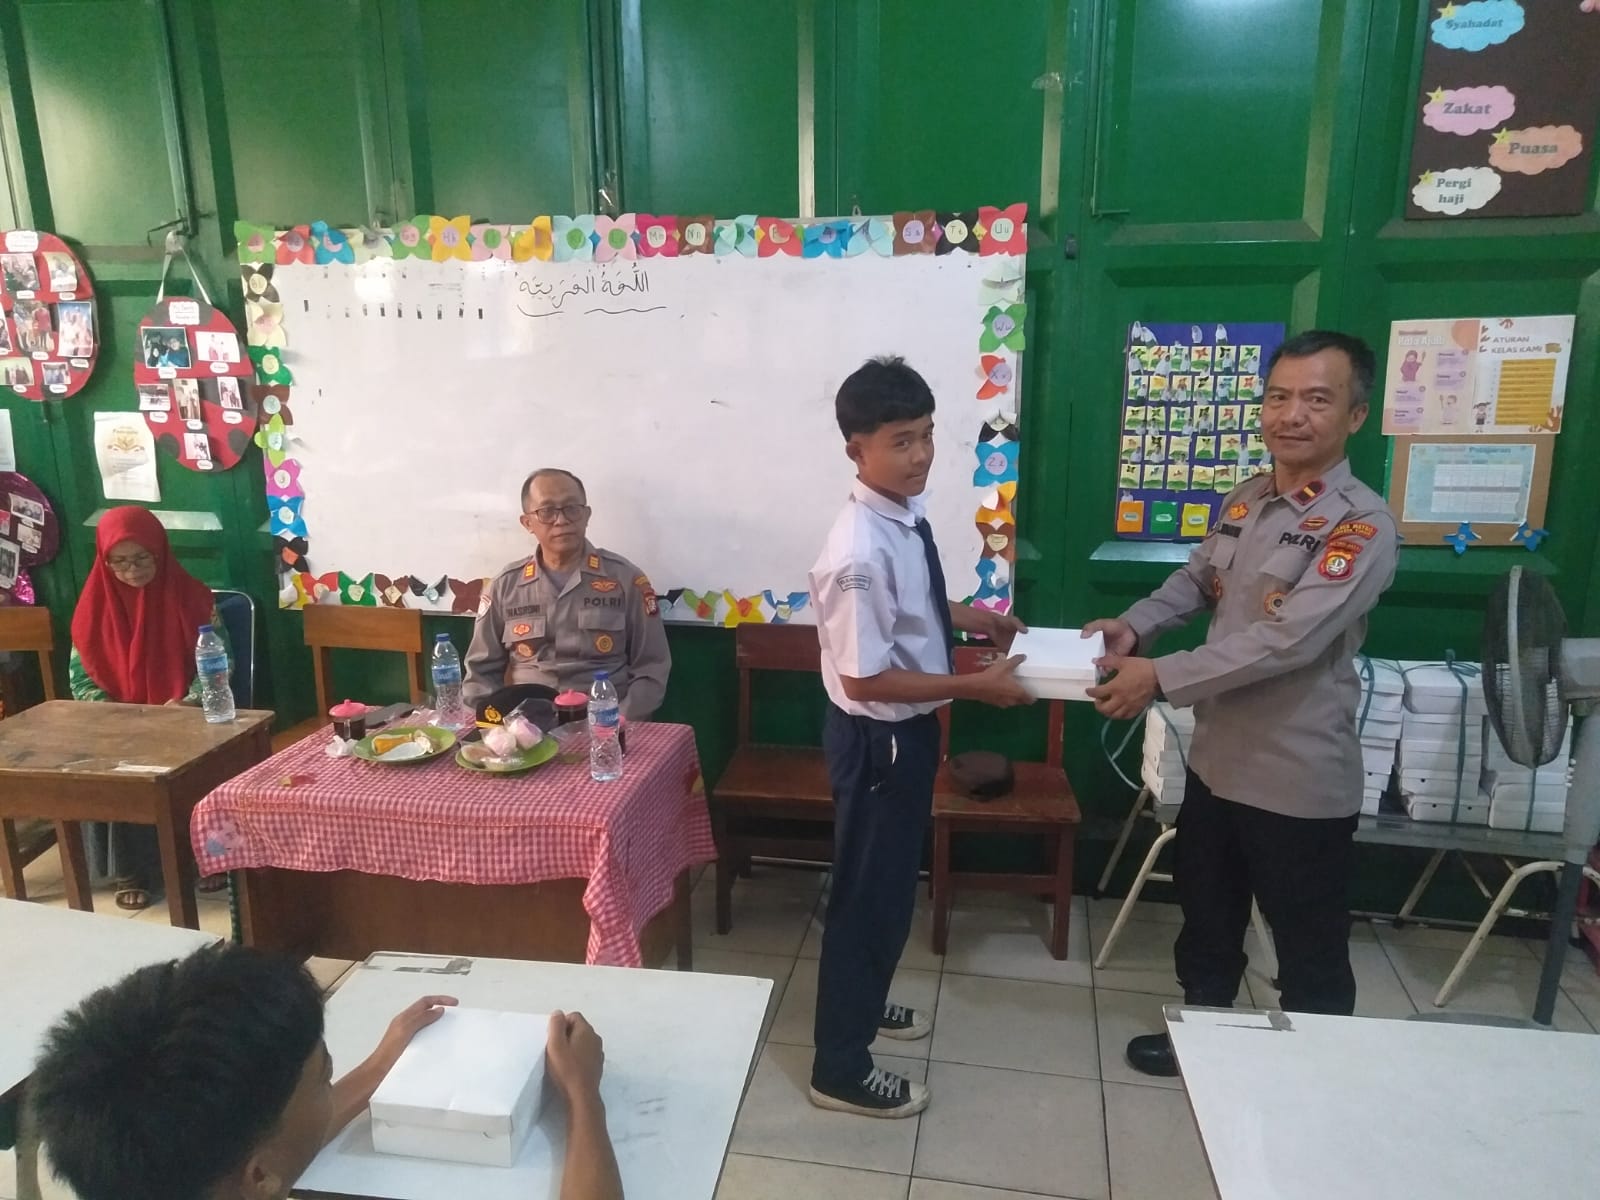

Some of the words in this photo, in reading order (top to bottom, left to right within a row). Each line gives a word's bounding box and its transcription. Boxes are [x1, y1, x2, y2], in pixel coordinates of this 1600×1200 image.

[1443, 102, 1492, 115] Zakat
[1508, 142, 1558, 155] Puasa
[1436, 177, 1472, 190] Pergi
[1438, 194, 1464, 206] haji
[1493, 335, 1530, 343] ATURAN
[1491, 346, 1517, 354] KELAS
[1519, 345, 1543, 353] KAMI
[583, 596, 621, 607] POLRI
